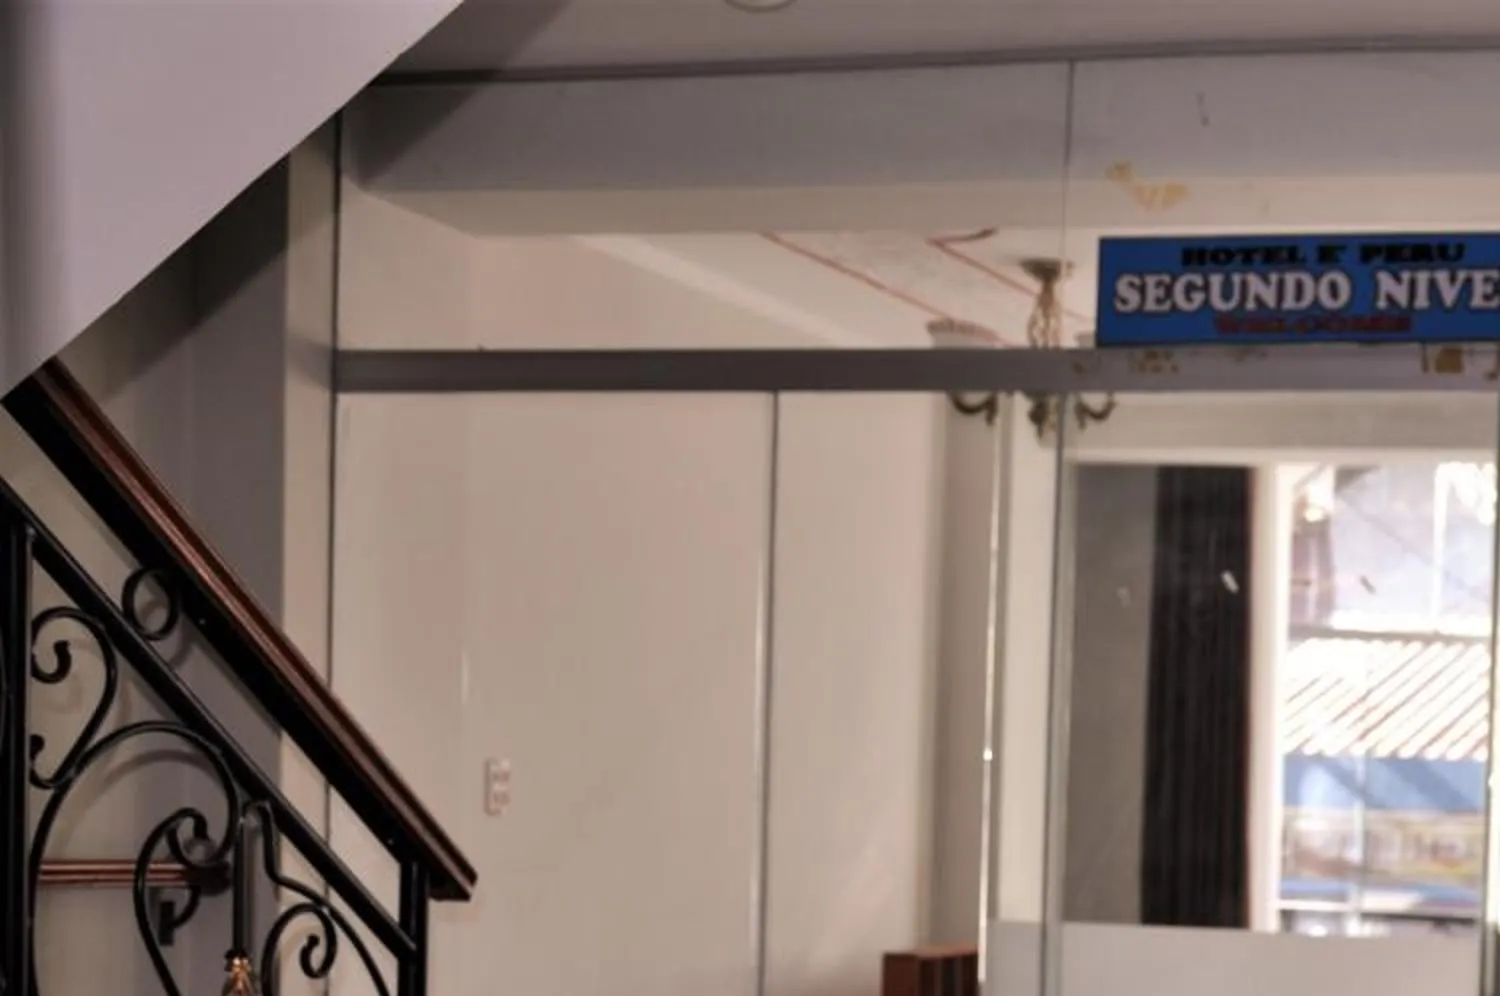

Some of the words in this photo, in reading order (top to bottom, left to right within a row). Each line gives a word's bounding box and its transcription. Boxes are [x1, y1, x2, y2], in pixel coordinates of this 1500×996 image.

[1181, 244, 1307, 266] HOTEL
[1359, 243, 1466, 263] PERU
[1113, 271, 1352, 313] SEGUNDO
